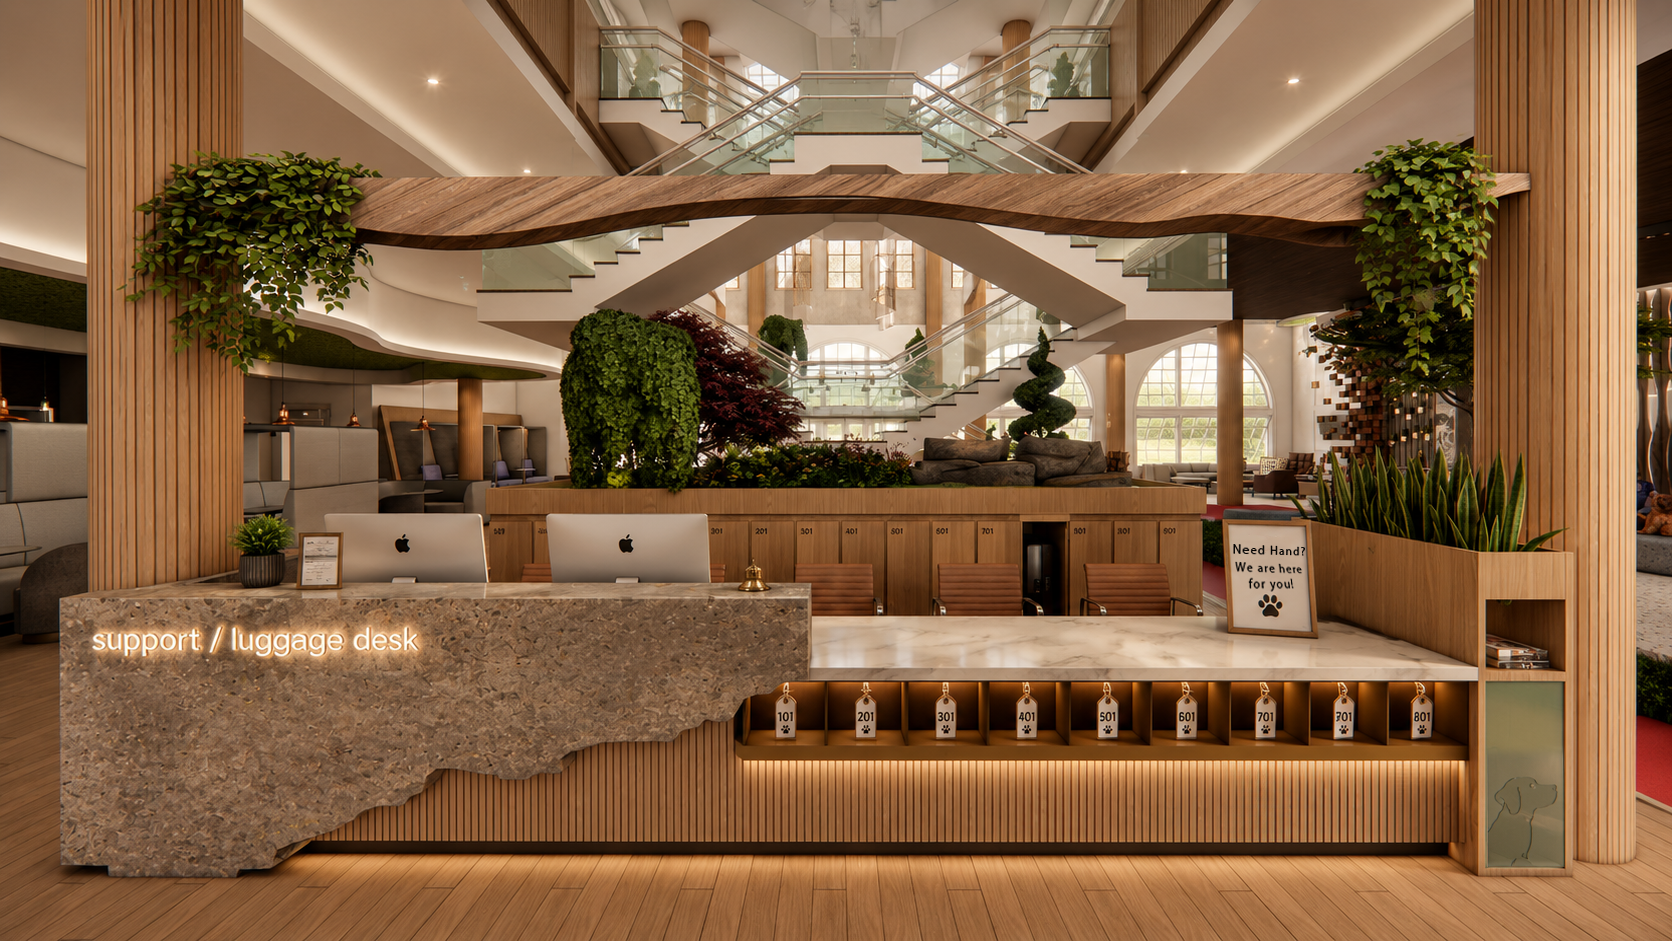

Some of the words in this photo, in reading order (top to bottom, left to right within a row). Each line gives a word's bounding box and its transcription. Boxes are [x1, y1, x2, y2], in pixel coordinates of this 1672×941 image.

[1232, 543, 1265, 555] Need
[1270, 545, 1306, 556] Hand?
[1235, 562, 1253, 572] We
[1257, 565, 1275, 573] are
[1279, 563, 1302, 574] here
[1248, 577, 1266, 589] for
[1269, 578, 1294, 592] you!
[91, 627, 201, 657] support
[209, 625, 223, 654] /
[231, 626, 344, 657] luggage
[353, 626, 419, 652] desk
[777, 711, 794, 722] 101
[857, 711, 874, 722] 201
[937, 711, 954, 722] 301
[1018, 711, 1035, 722] 401
[1178, 711, 1195, 722] 601
[1257, 711, 1274, 722] 701
[1414, 711, 1431, 722] 801
